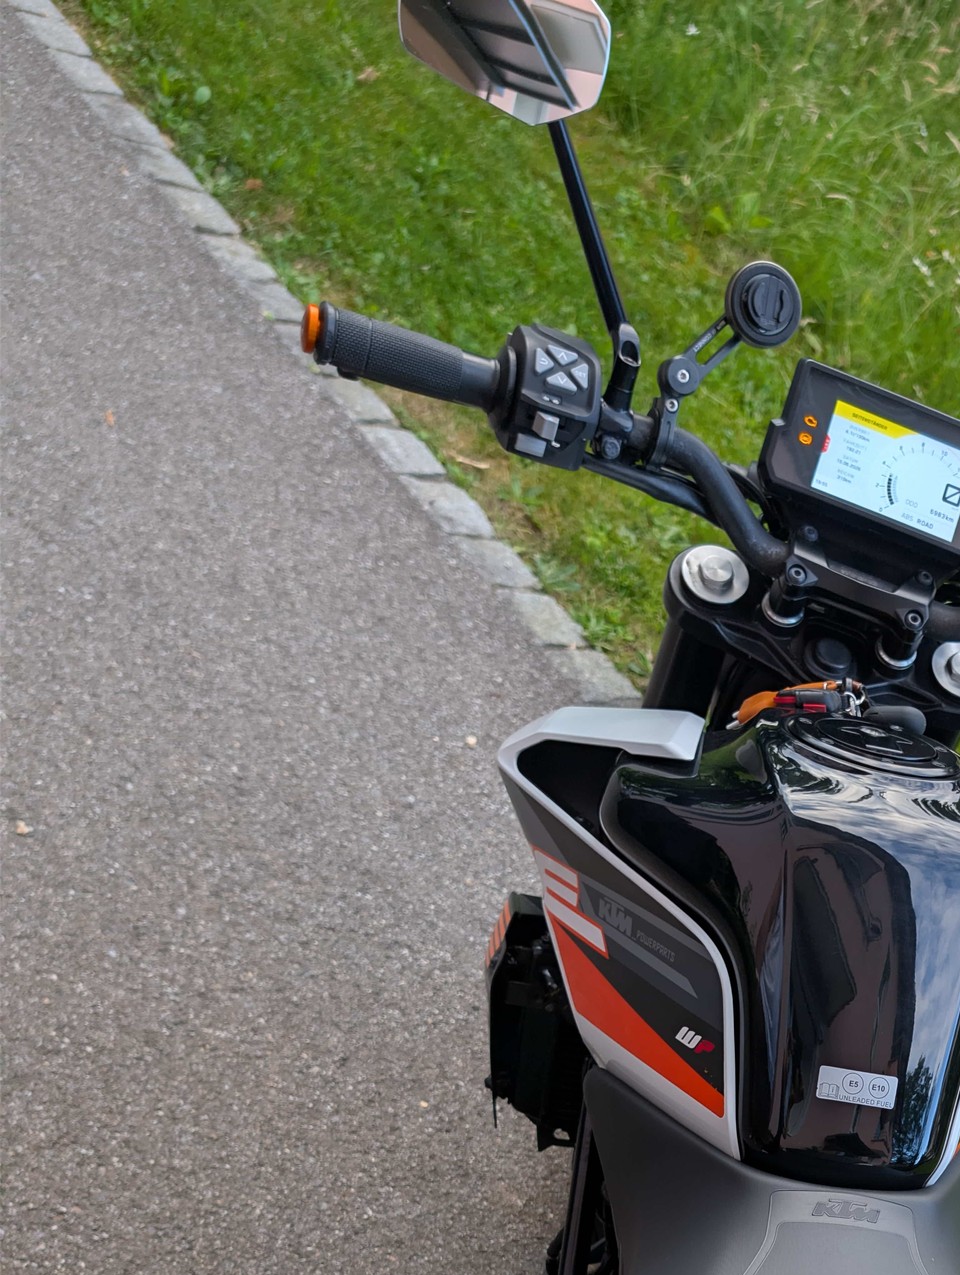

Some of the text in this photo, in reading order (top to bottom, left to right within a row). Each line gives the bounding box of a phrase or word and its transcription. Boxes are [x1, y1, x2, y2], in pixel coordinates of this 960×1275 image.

[916, 518, 934, 530] ROAD
[598, 896, 632, 938] KTM
[848, 1080, 859, 1088] E5
[871, 1083, 885, 1093] E10
[838, 1093, 893, 1109] UNLEADED FUEL
[812, 1198, 880, 1223] KTM
